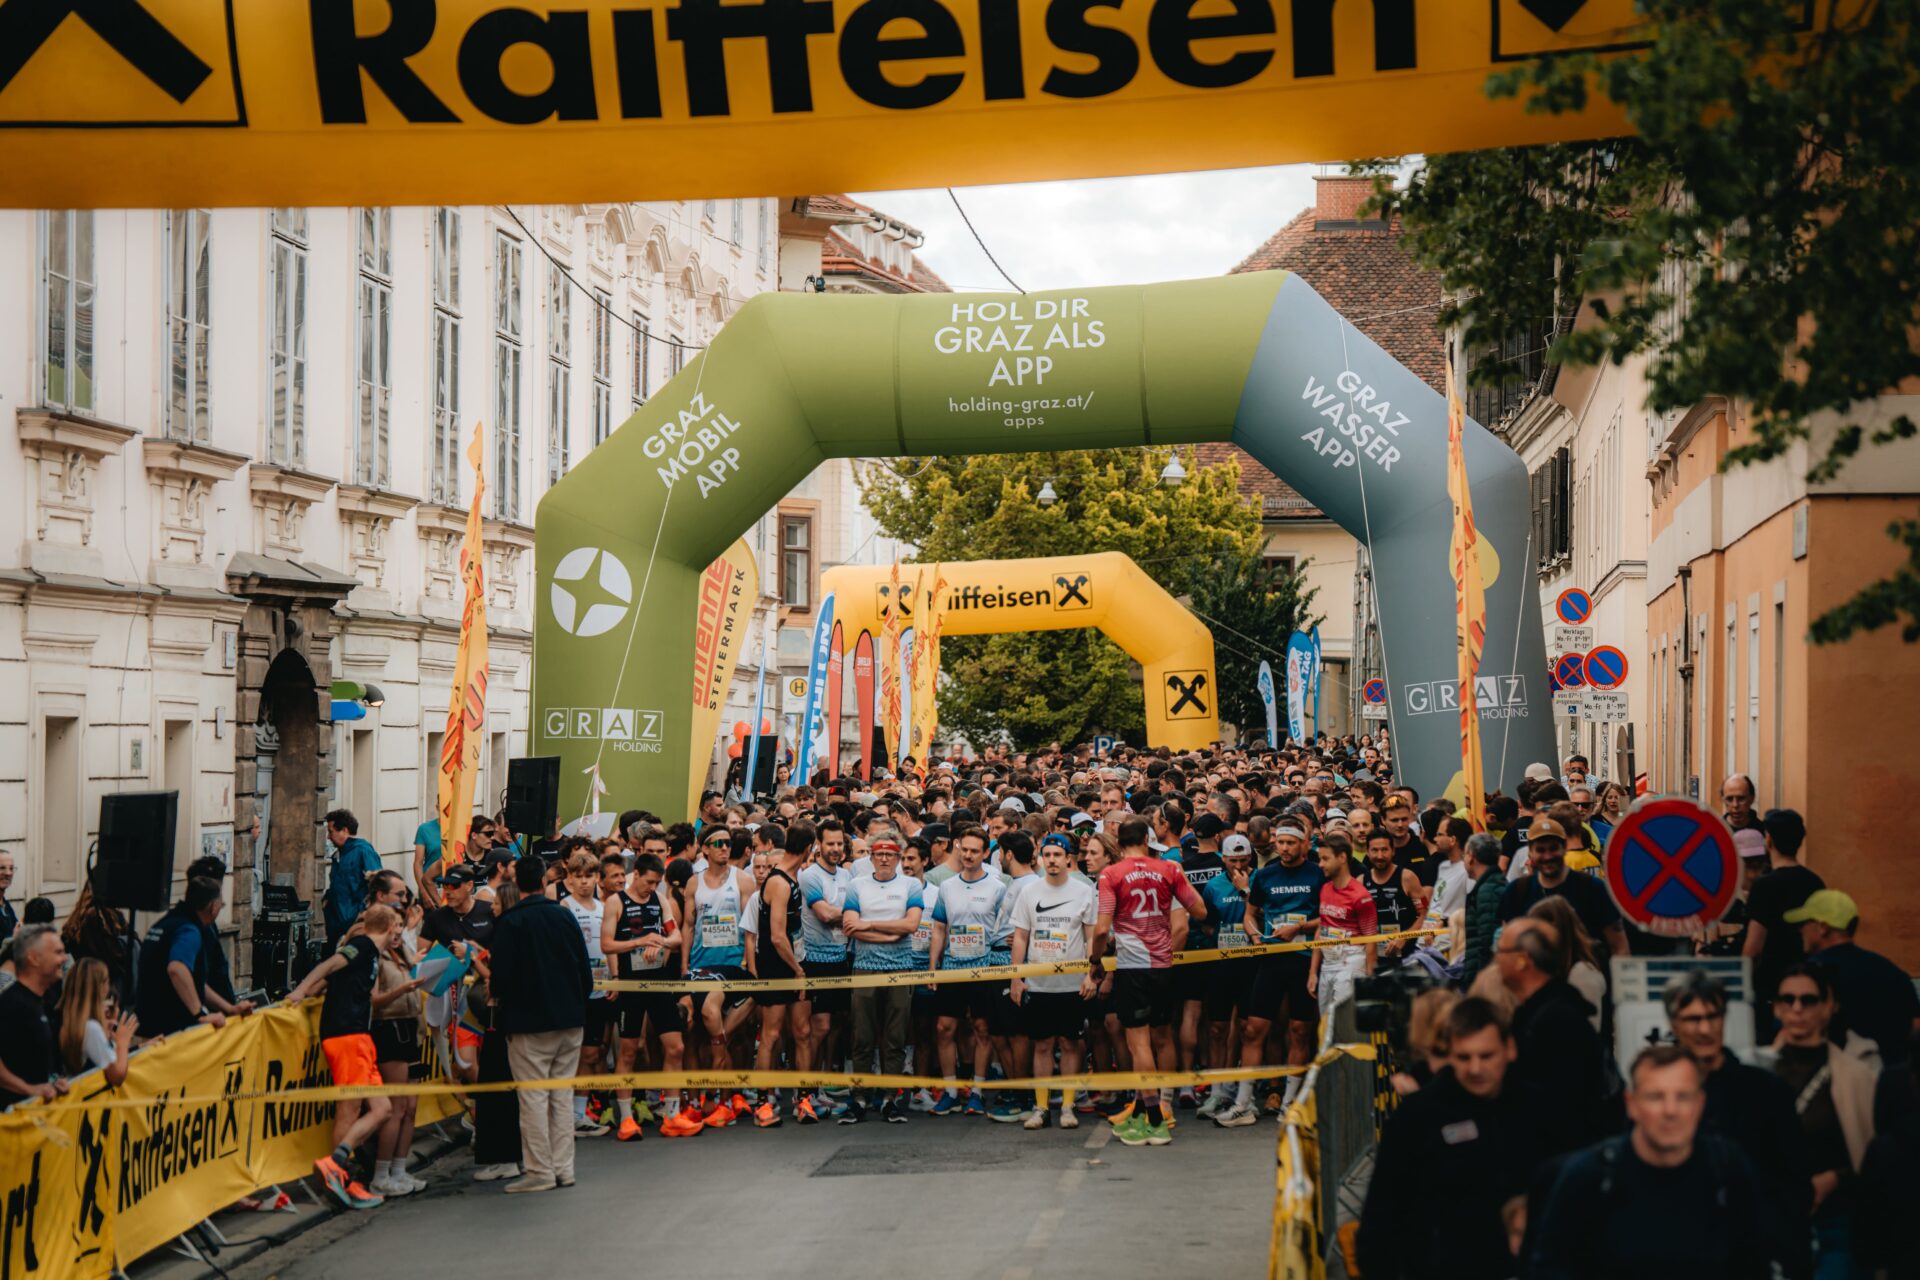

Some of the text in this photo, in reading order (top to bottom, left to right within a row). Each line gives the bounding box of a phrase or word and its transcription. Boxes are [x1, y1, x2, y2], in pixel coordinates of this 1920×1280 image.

[309, 0, 1418, 125] Raiffeisen
[952, 298, 1090, 322] HOL DIR
[934, 320, 1106, 354] GRAZ ALS
[988, 356, 1053, 387] APP
[949, 391, 1095, 414] holding-graz.at/
[1336, 370, 1412, 437] GRAZ
[642, 392, 715, 459] GRAZ
[1004, 415, 1045, 429] apps
[1302, 375, 1401, 473] WASSER
[657, 413, 741, 489] MOBIL
[1300, 427, 1356, 469] APP
[696, 447, 741, 499] APP
[710, 568, 745, 711] STEIERMARK
[794, 682, 804, 693] H
[1408, 679, 1522, 712] GRAZ
[547, 711, 658, 738] GRAZ
[1481, 707, 1529, 719] HOLDING
[613, 742, 662, 754] HOLDING
[1185, 870, 1222, 882] NAPP
[1270, 885, 1311, 895] SIEMENS
[1130, 888, 1163, 919] 21
[956, 935, 978, 944] 339C
[981, 966, 1018, 975] Raiffeisen
[117, 1087, 219, 1213] Raiffeisen
[0, 1148, 42, 1280] rt
